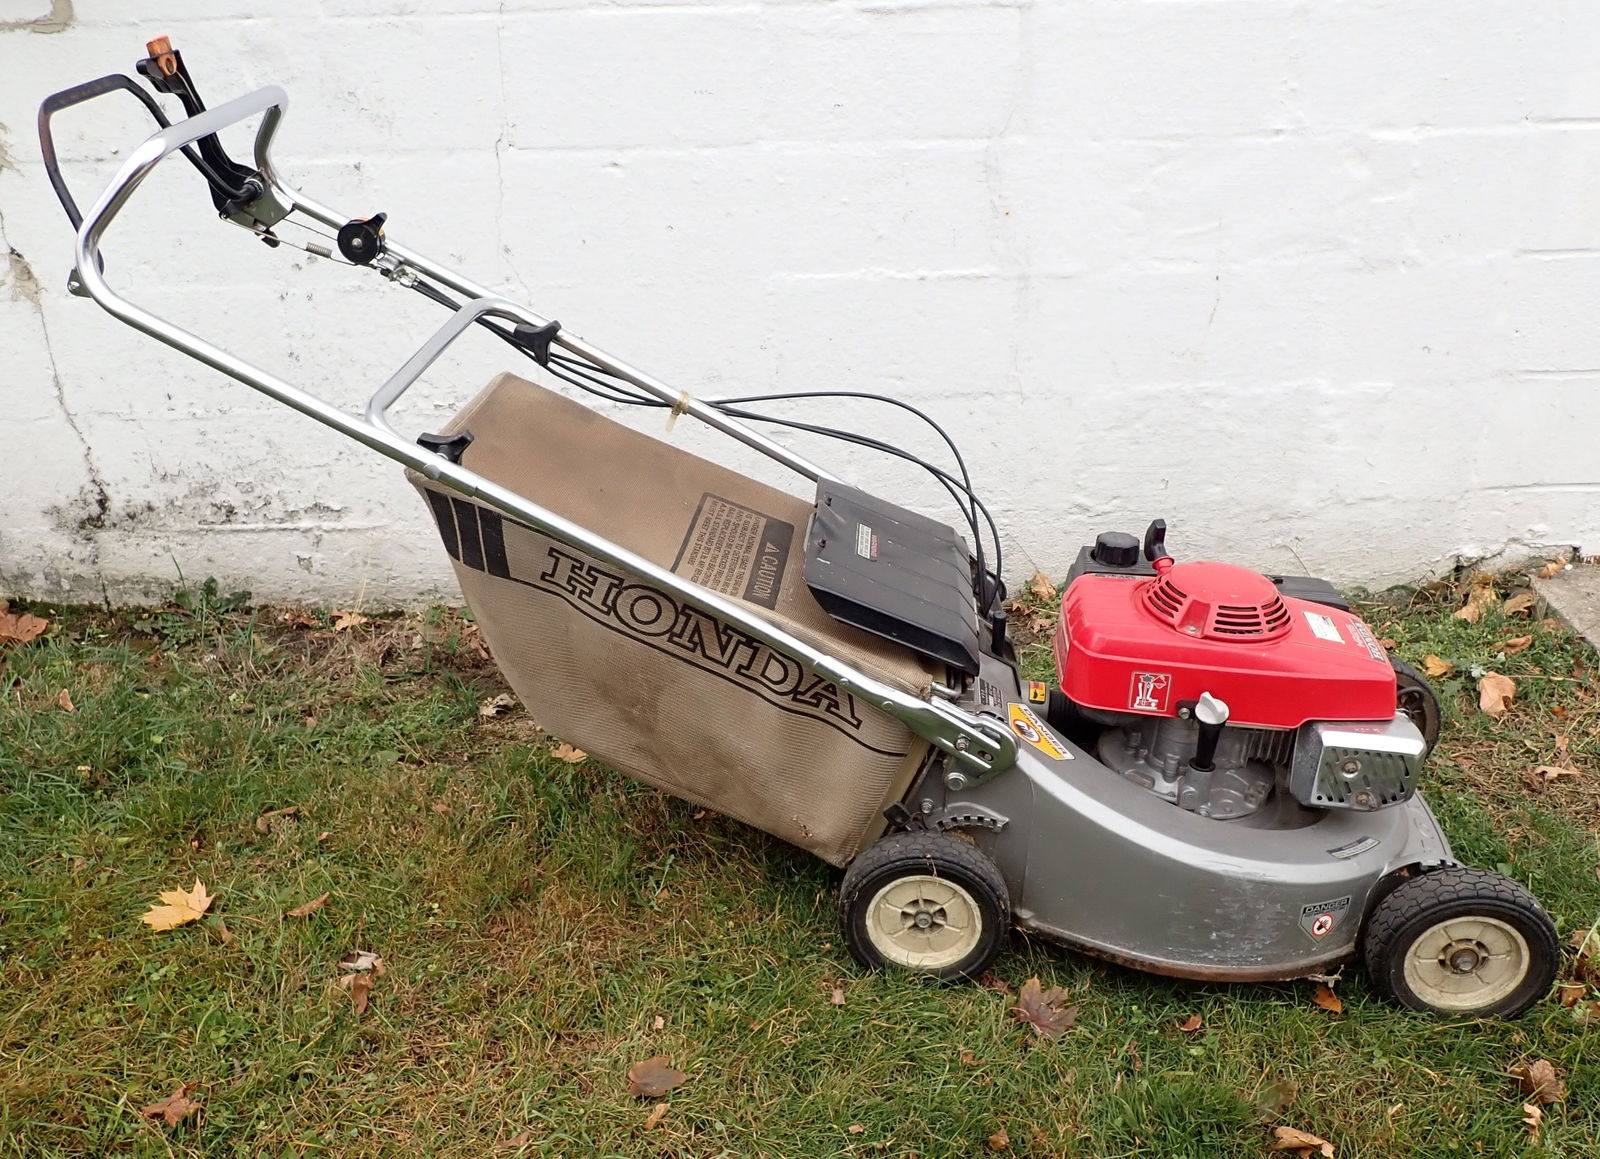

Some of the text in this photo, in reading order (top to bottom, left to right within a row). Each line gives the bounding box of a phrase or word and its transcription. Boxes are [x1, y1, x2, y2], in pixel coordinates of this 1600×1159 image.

[695, 530, 706, 543] THIS
[736, 518, 751, 543] SUBJECT
[734, 542, 743, 551] TO
[751, 552, 779, 601] CAUTION
[541, 546, 863, 730] HONDA
[1023, 707, 1069, 755] DANGER
[1305, 898, 1348, 913] DANGER
